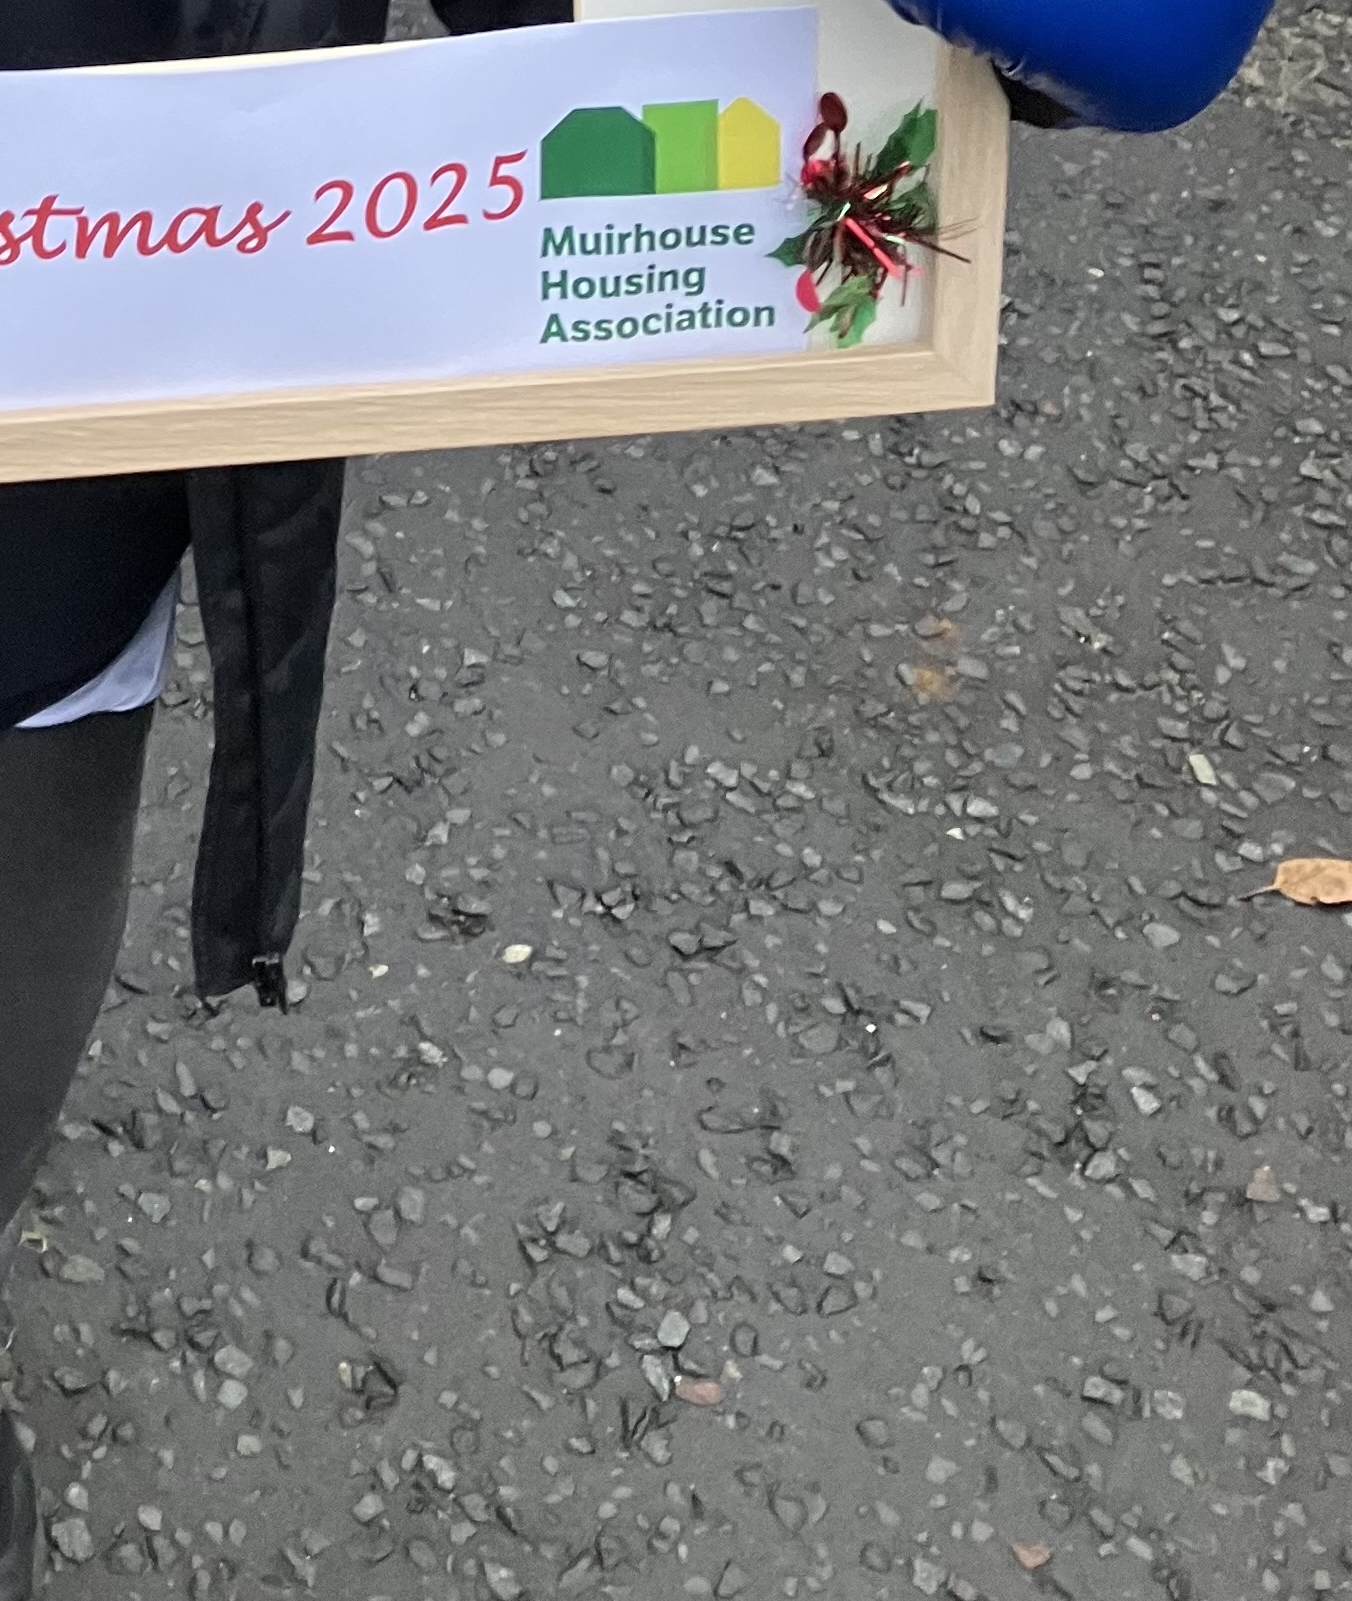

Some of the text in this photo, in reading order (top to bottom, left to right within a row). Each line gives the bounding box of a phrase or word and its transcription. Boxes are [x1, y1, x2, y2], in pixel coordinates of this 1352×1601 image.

[306, 149, 528, 247] 2025
[540, 222, 755, 258] Muirhouse
[540, 264, 706, 300] Housing
[539, 299, 775, 344] Association
